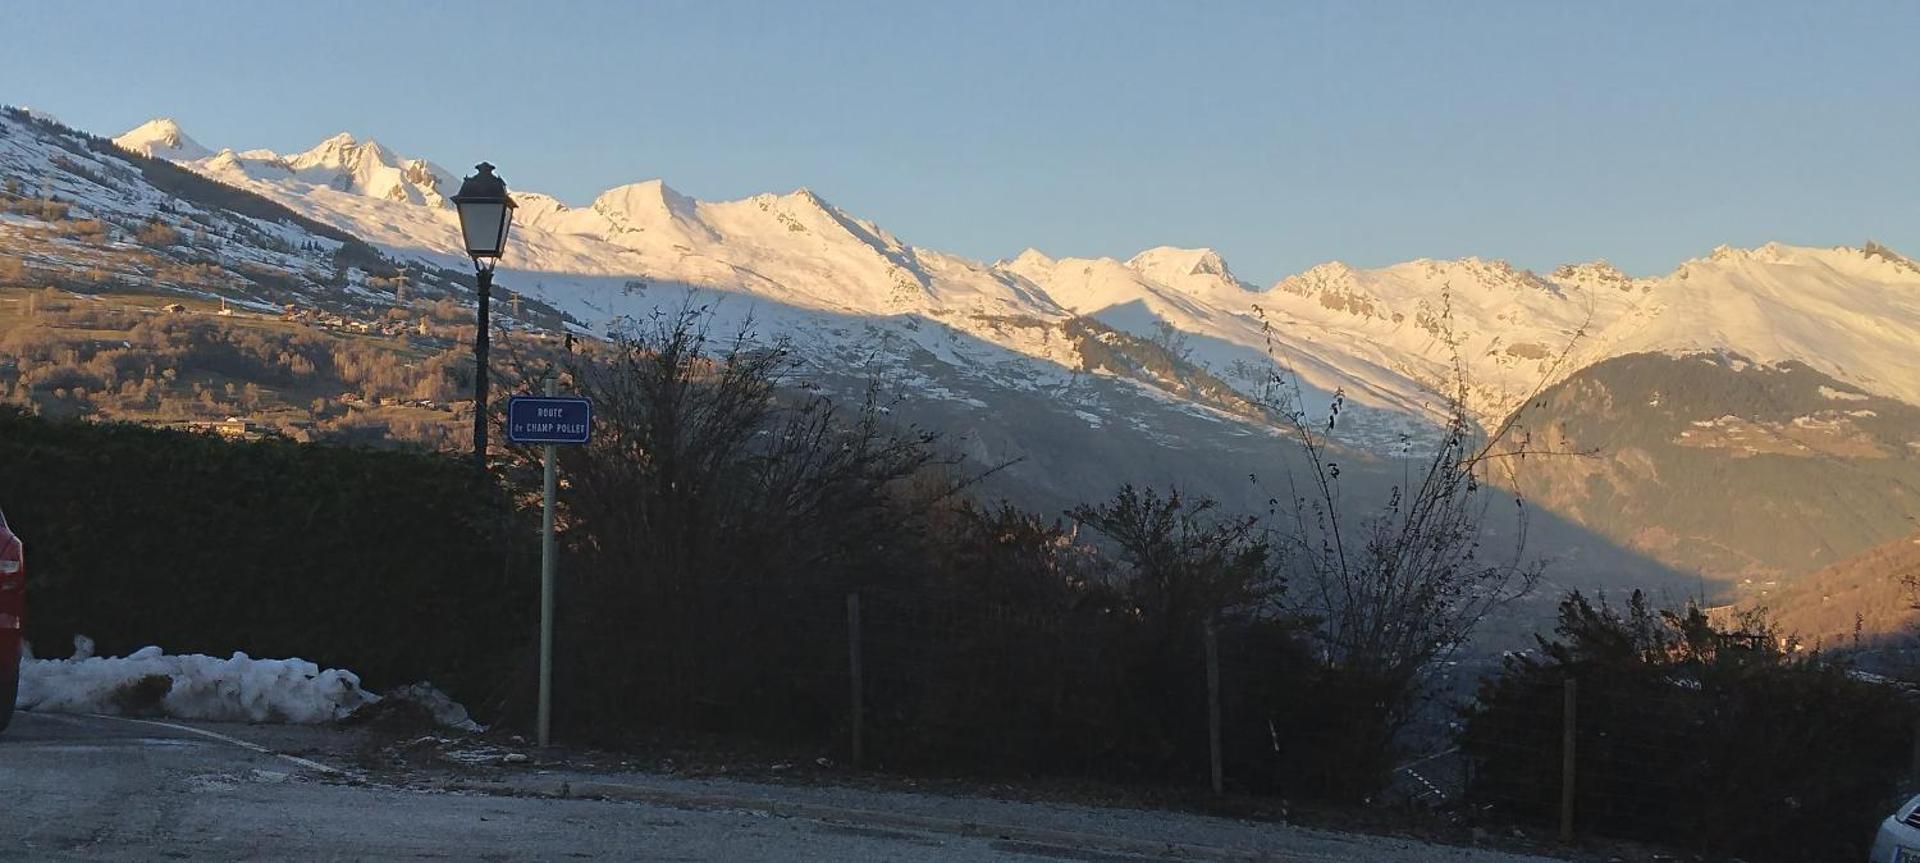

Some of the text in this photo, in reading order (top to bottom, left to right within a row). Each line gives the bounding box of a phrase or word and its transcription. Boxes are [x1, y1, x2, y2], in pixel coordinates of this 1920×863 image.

[538, 408, 563, 418] ROUTE
[526, 423, 553, 432] CHAMP
[556, 423, 585, 433] POLLET
